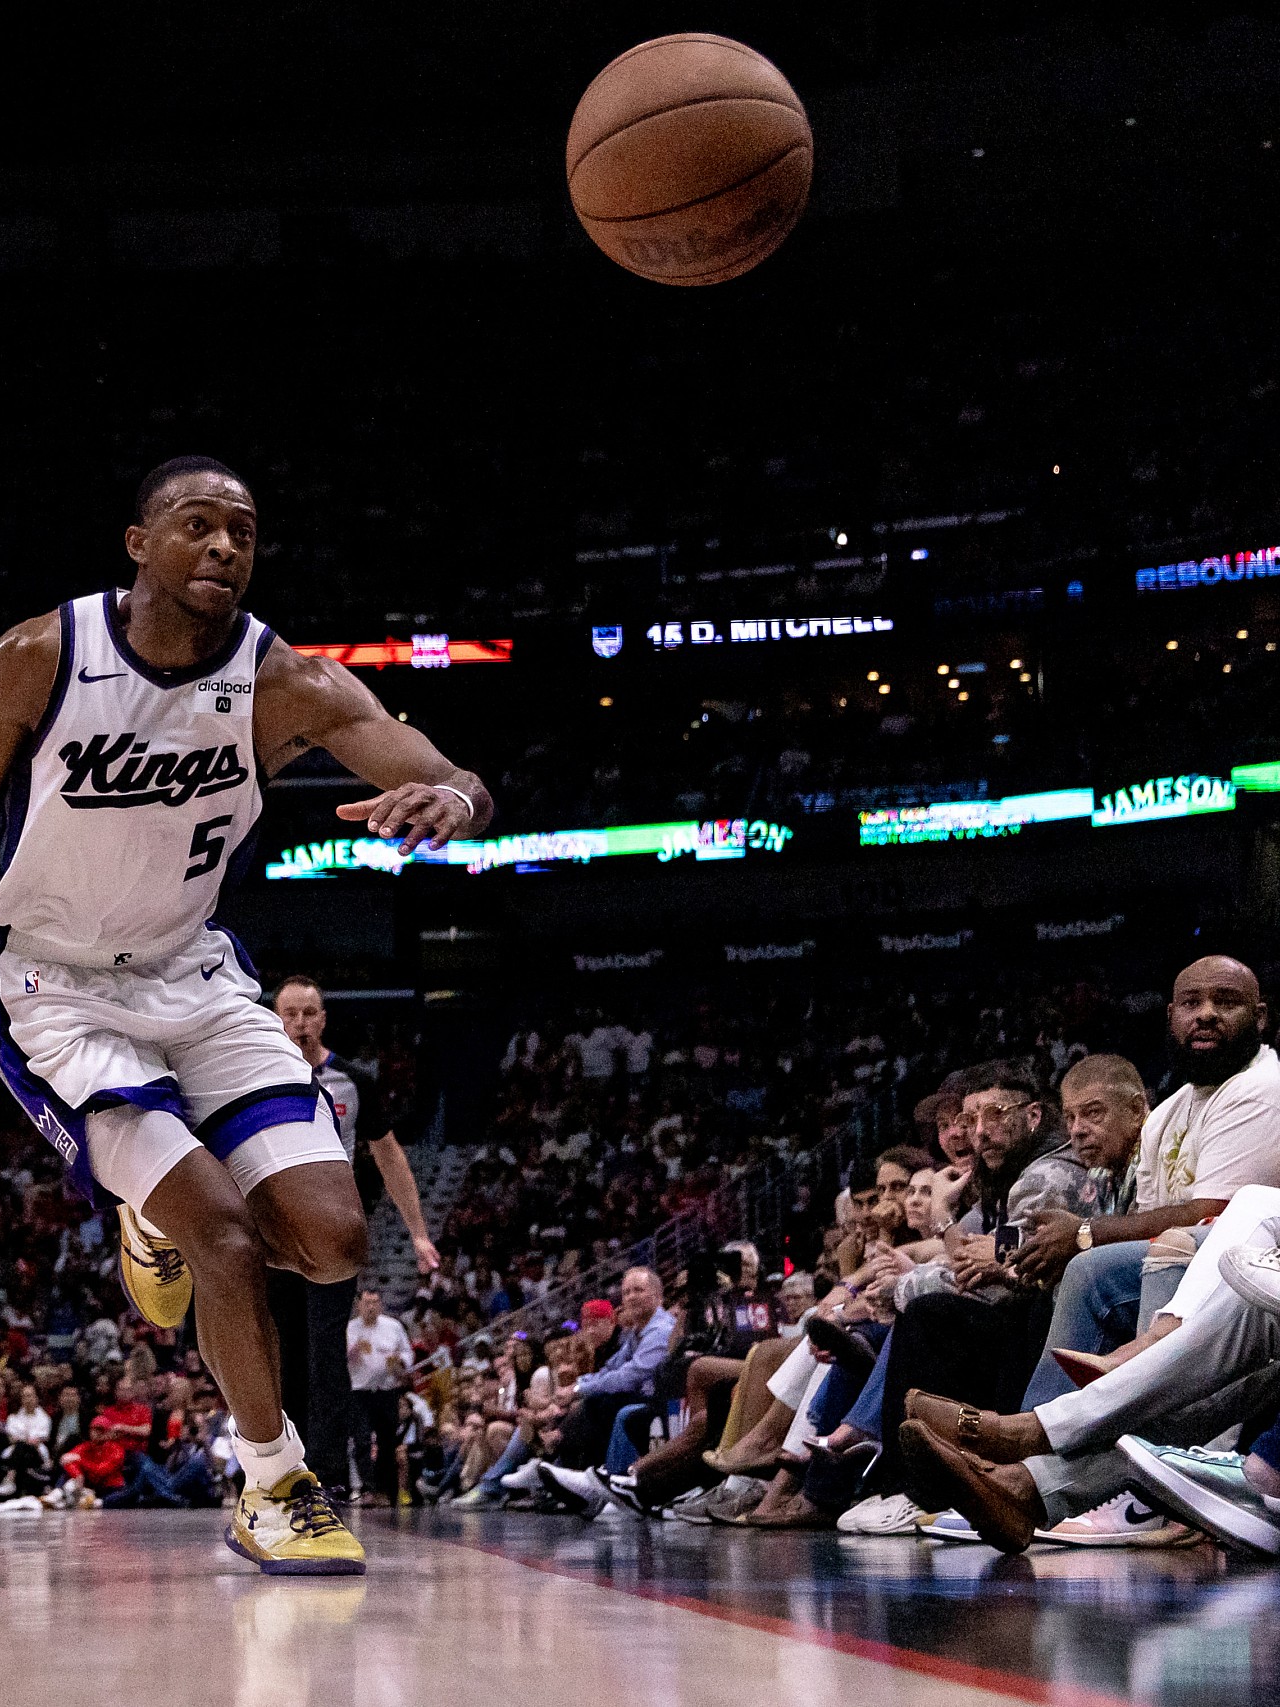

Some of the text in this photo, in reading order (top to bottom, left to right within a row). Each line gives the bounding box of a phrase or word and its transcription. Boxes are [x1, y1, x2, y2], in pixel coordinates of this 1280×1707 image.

[730, 616, 894, 642] MITCHELL
[198, 679, 252, 695] dialpad
[58, 732, 249, 809] Kings
[1101, 776, 1236, 818] JAMESON
[183, 815, 233, 882] 5
[279, 838, 410, 876] JAMES
